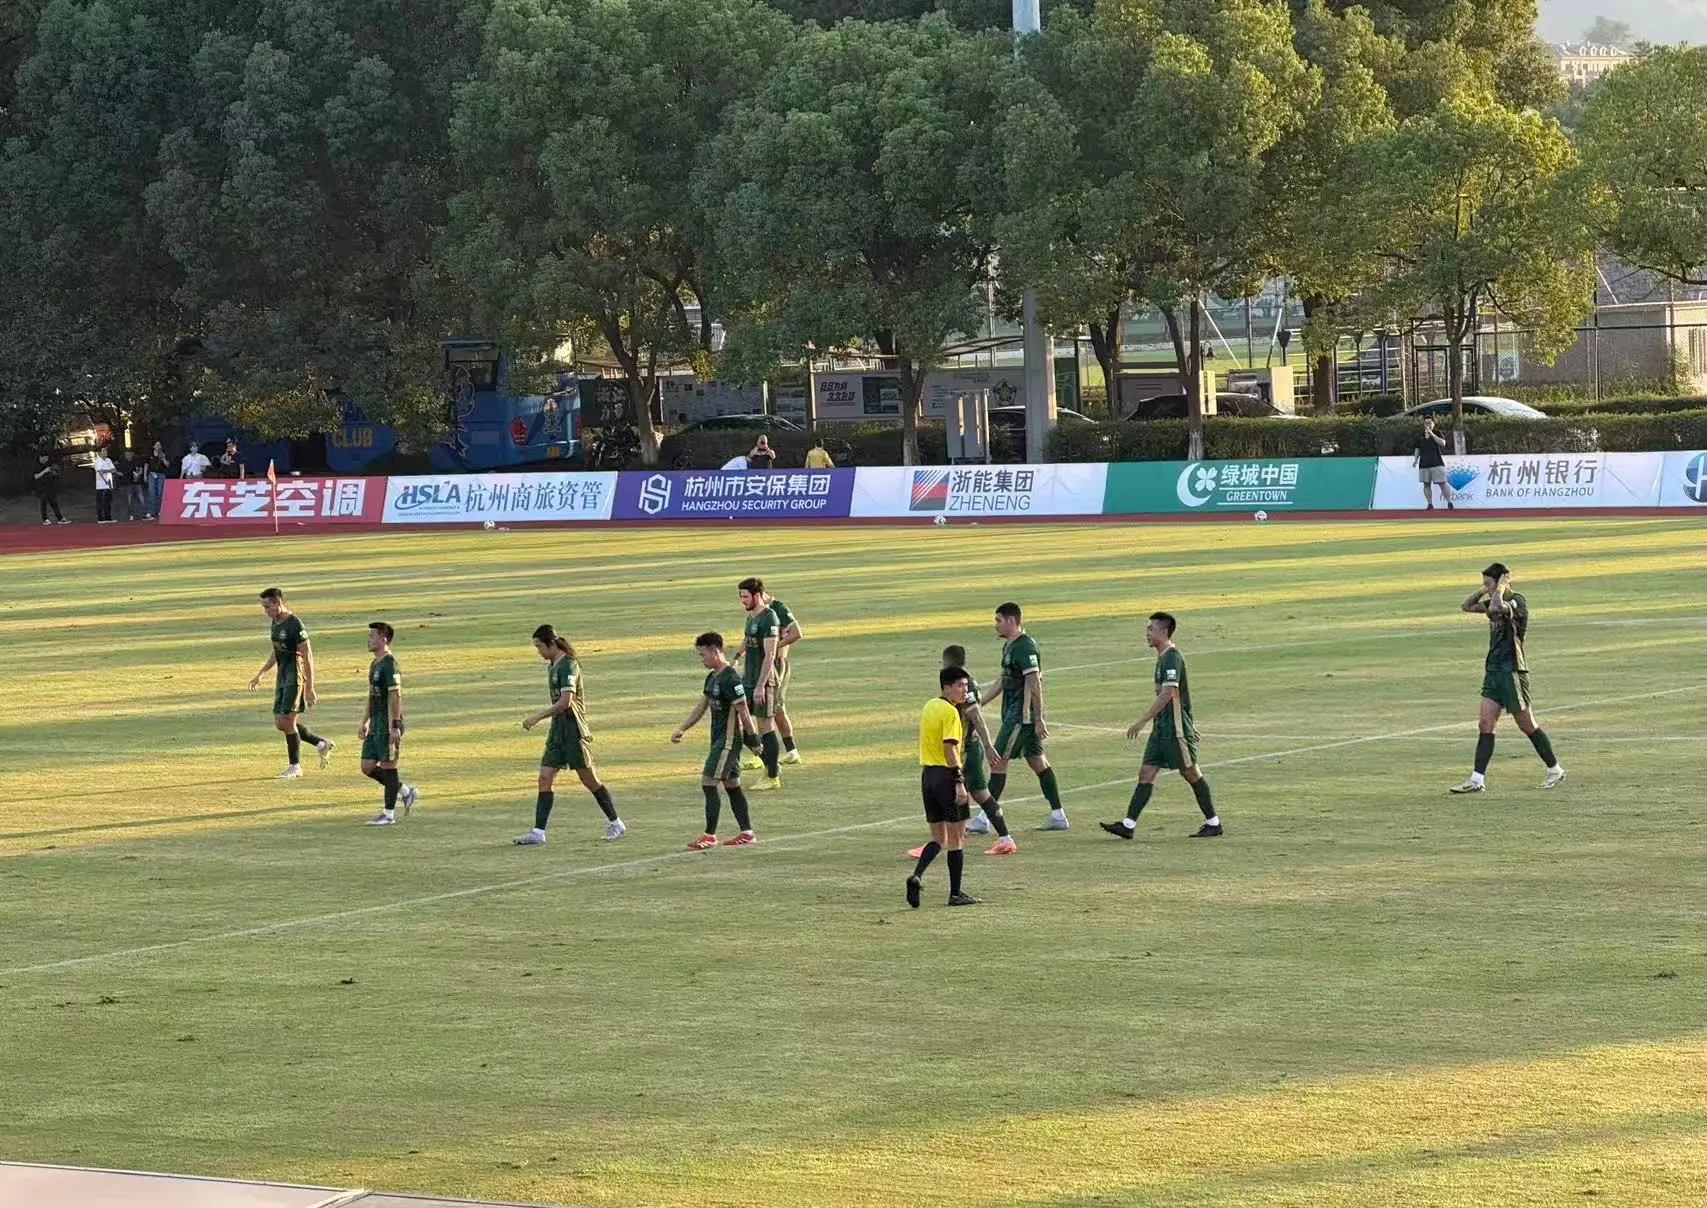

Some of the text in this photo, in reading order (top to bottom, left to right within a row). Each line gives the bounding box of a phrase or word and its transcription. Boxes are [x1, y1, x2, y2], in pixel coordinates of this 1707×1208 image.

[333, 427, 373, 448] CLUB
[951, 470, 1034, 493] 浙能集团
[1220, 463, 1299, 486] 绿城中国
[1487, 459, 1598, 485] 杭州银行
[400, 483, 462, 504] HSLA
[465, 480, 603, 512] 杭州商旅资管
[684, 474, 832, 497] 杭州市安保集团
[1226, 490, 1288, 502] GREENTOWN
[1485, 486, 1595, 498] BANK OF HANGZHOU
[181, 479, 366, 518] 东艺空调
[681, 498, 827, 512] HANGZHOU SECURITY GROUP
[948, 494, 1031, 511] ZHENENG
